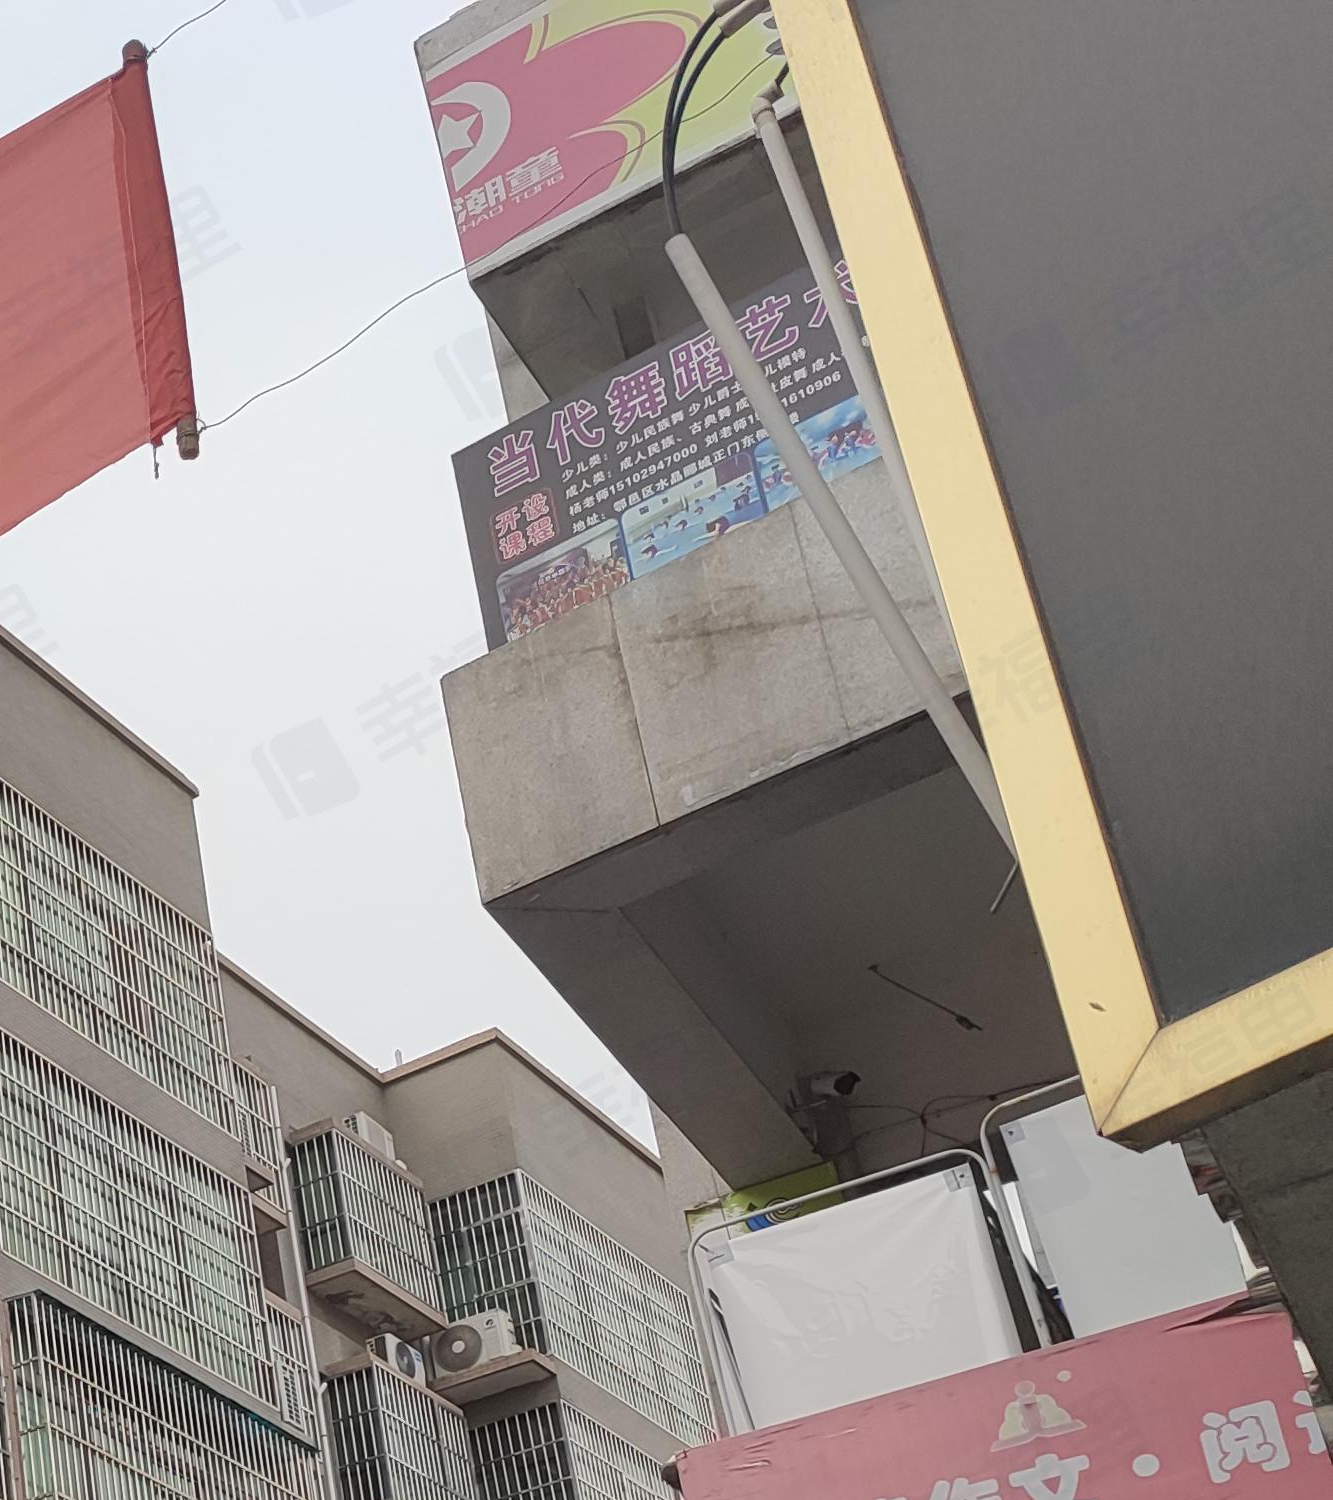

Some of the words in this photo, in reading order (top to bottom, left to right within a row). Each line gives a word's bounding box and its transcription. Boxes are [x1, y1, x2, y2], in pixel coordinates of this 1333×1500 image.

[764, 347, 808, 378] 儿模特
[688, 381, 745, 417] 少儿爵士
